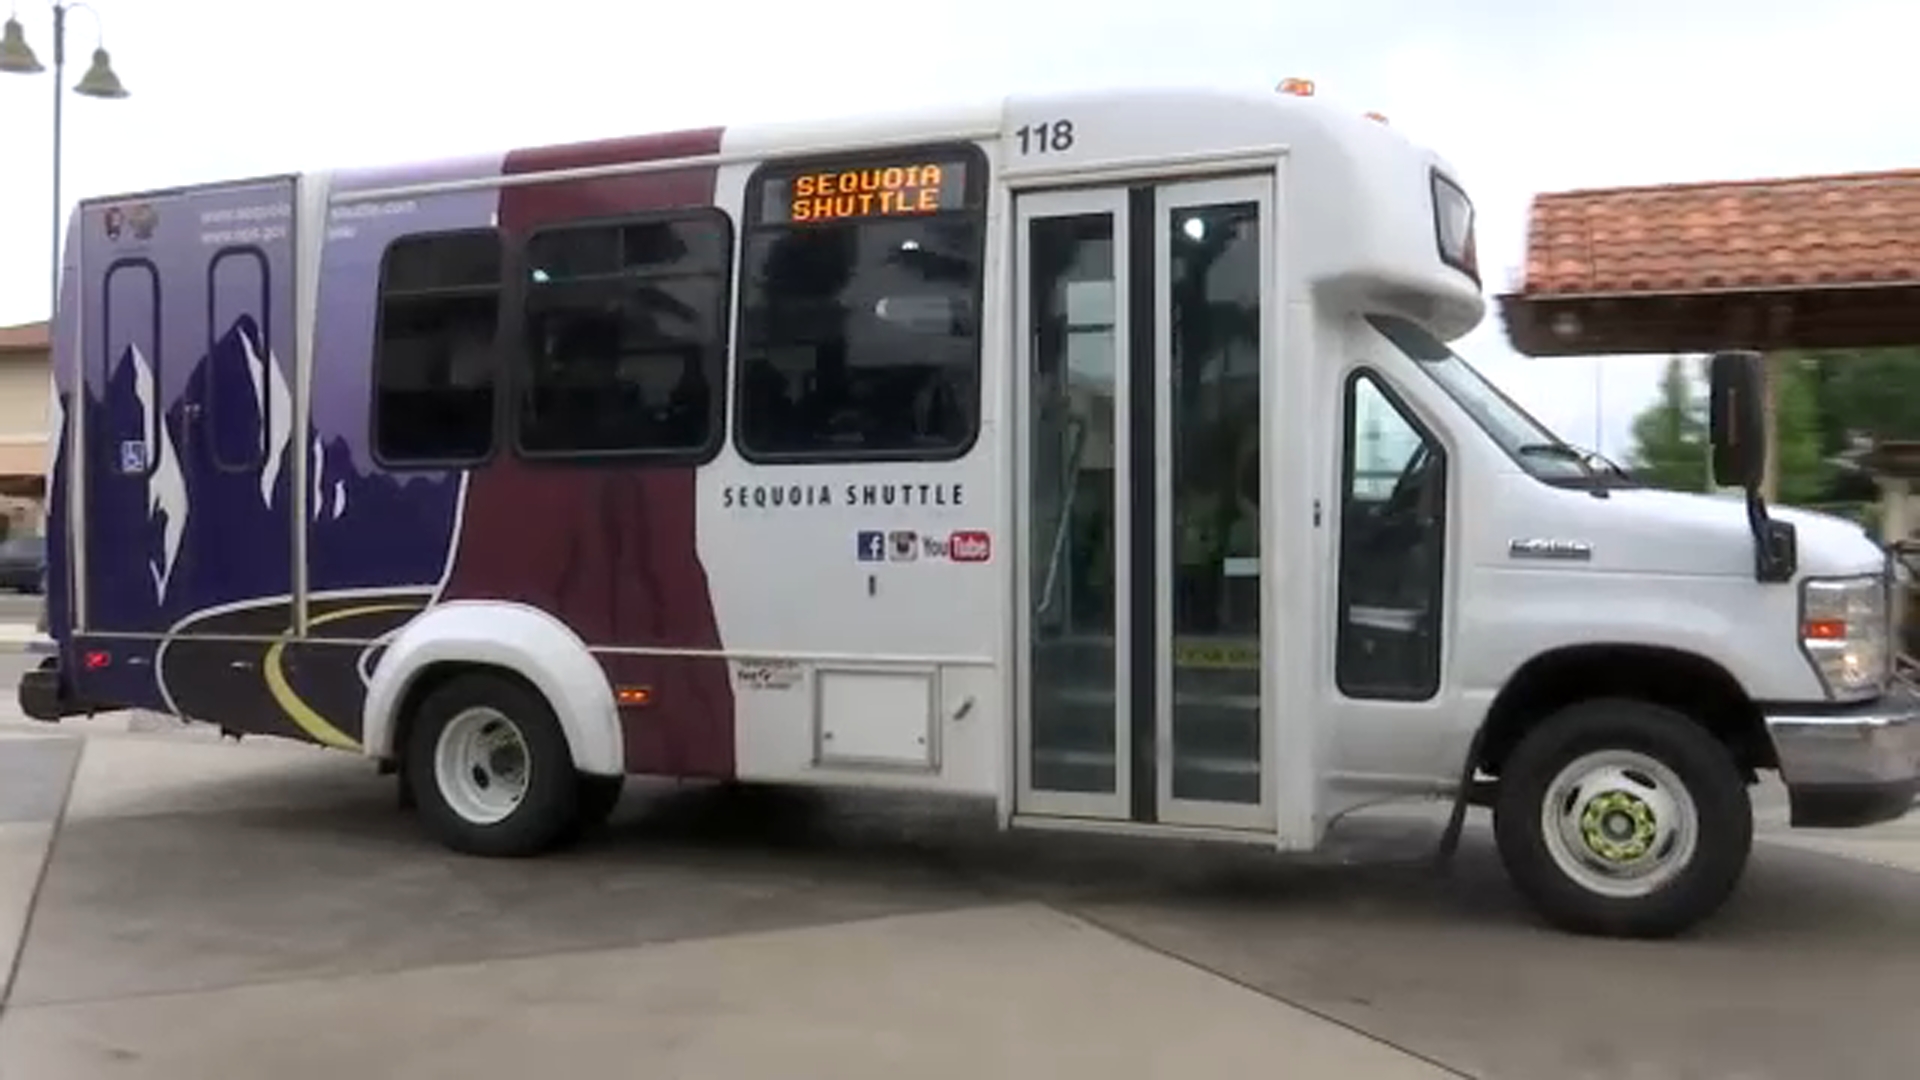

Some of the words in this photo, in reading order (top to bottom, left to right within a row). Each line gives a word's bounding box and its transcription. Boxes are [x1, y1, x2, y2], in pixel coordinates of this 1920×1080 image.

[1016, 119, 1074, 155] 118
[796, 164, 942, 197] SEQUOIA
[791, 187, 939, 221] SHUTTLE
[723, 485, 832, 508] SEQUOIA
[846, 484, 963, 506] SHUTTLE
[922, 531, 991, 562] YouTube
